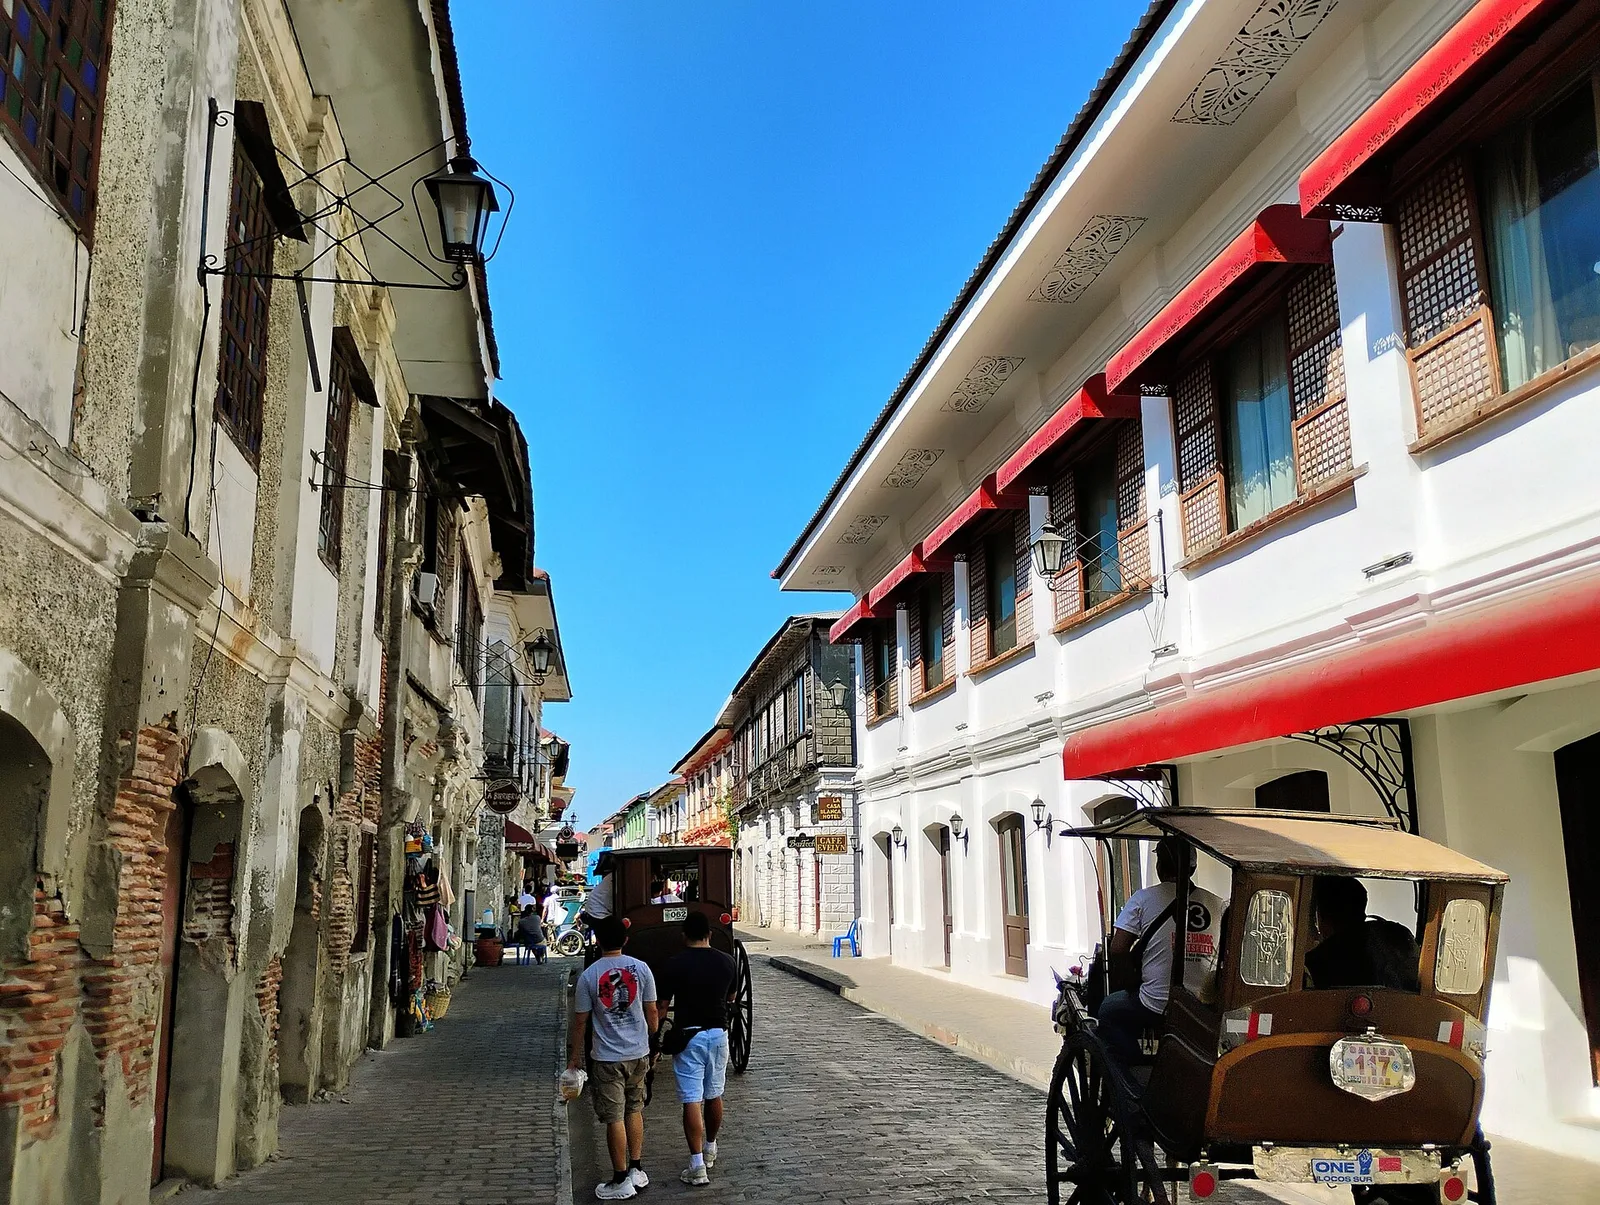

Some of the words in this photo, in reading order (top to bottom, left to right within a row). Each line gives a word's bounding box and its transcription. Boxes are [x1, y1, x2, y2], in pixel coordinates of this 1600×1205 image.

[1189, 904, 1205, 928] 3
[1355, 1055, 1390, 1076] 117
[1315, 1161, 1355, 1173] ONE
